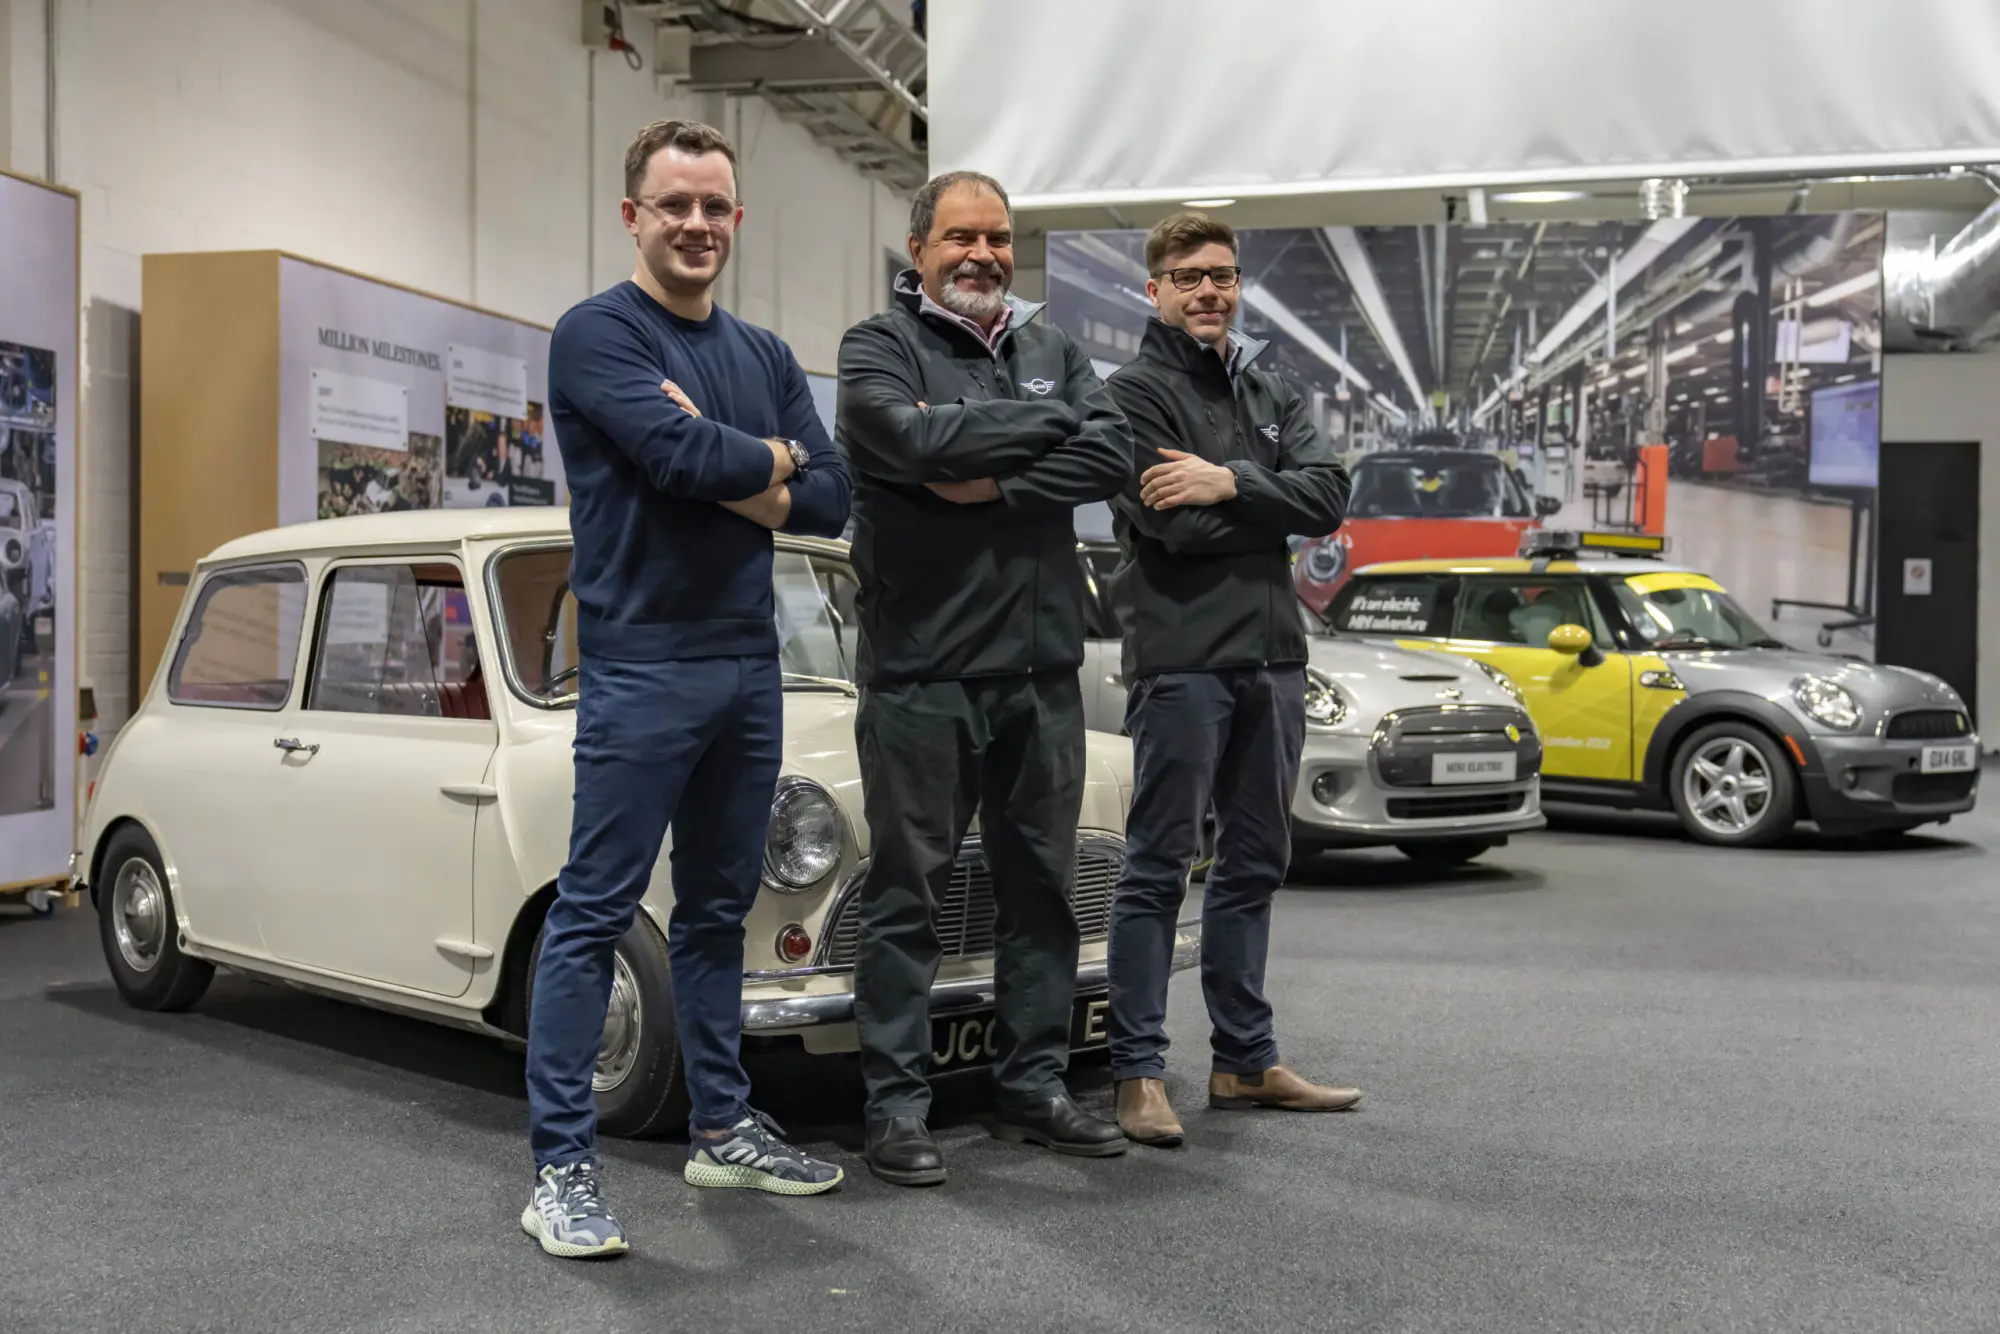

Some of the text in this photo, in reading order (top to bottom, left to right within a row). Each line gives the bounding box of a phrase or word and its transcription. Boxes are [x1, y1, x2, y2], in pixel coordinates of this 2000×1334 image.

[318, 327, 441, 371] MILLION MILESTONES
[1382, 596, 1422, 612] electric
[1348, 614, 1428, 632] MINI adventure
[1544, 734, 1612, 749] London 2012
[1446, 761, 1504, 774] MINI ELECTRIC
